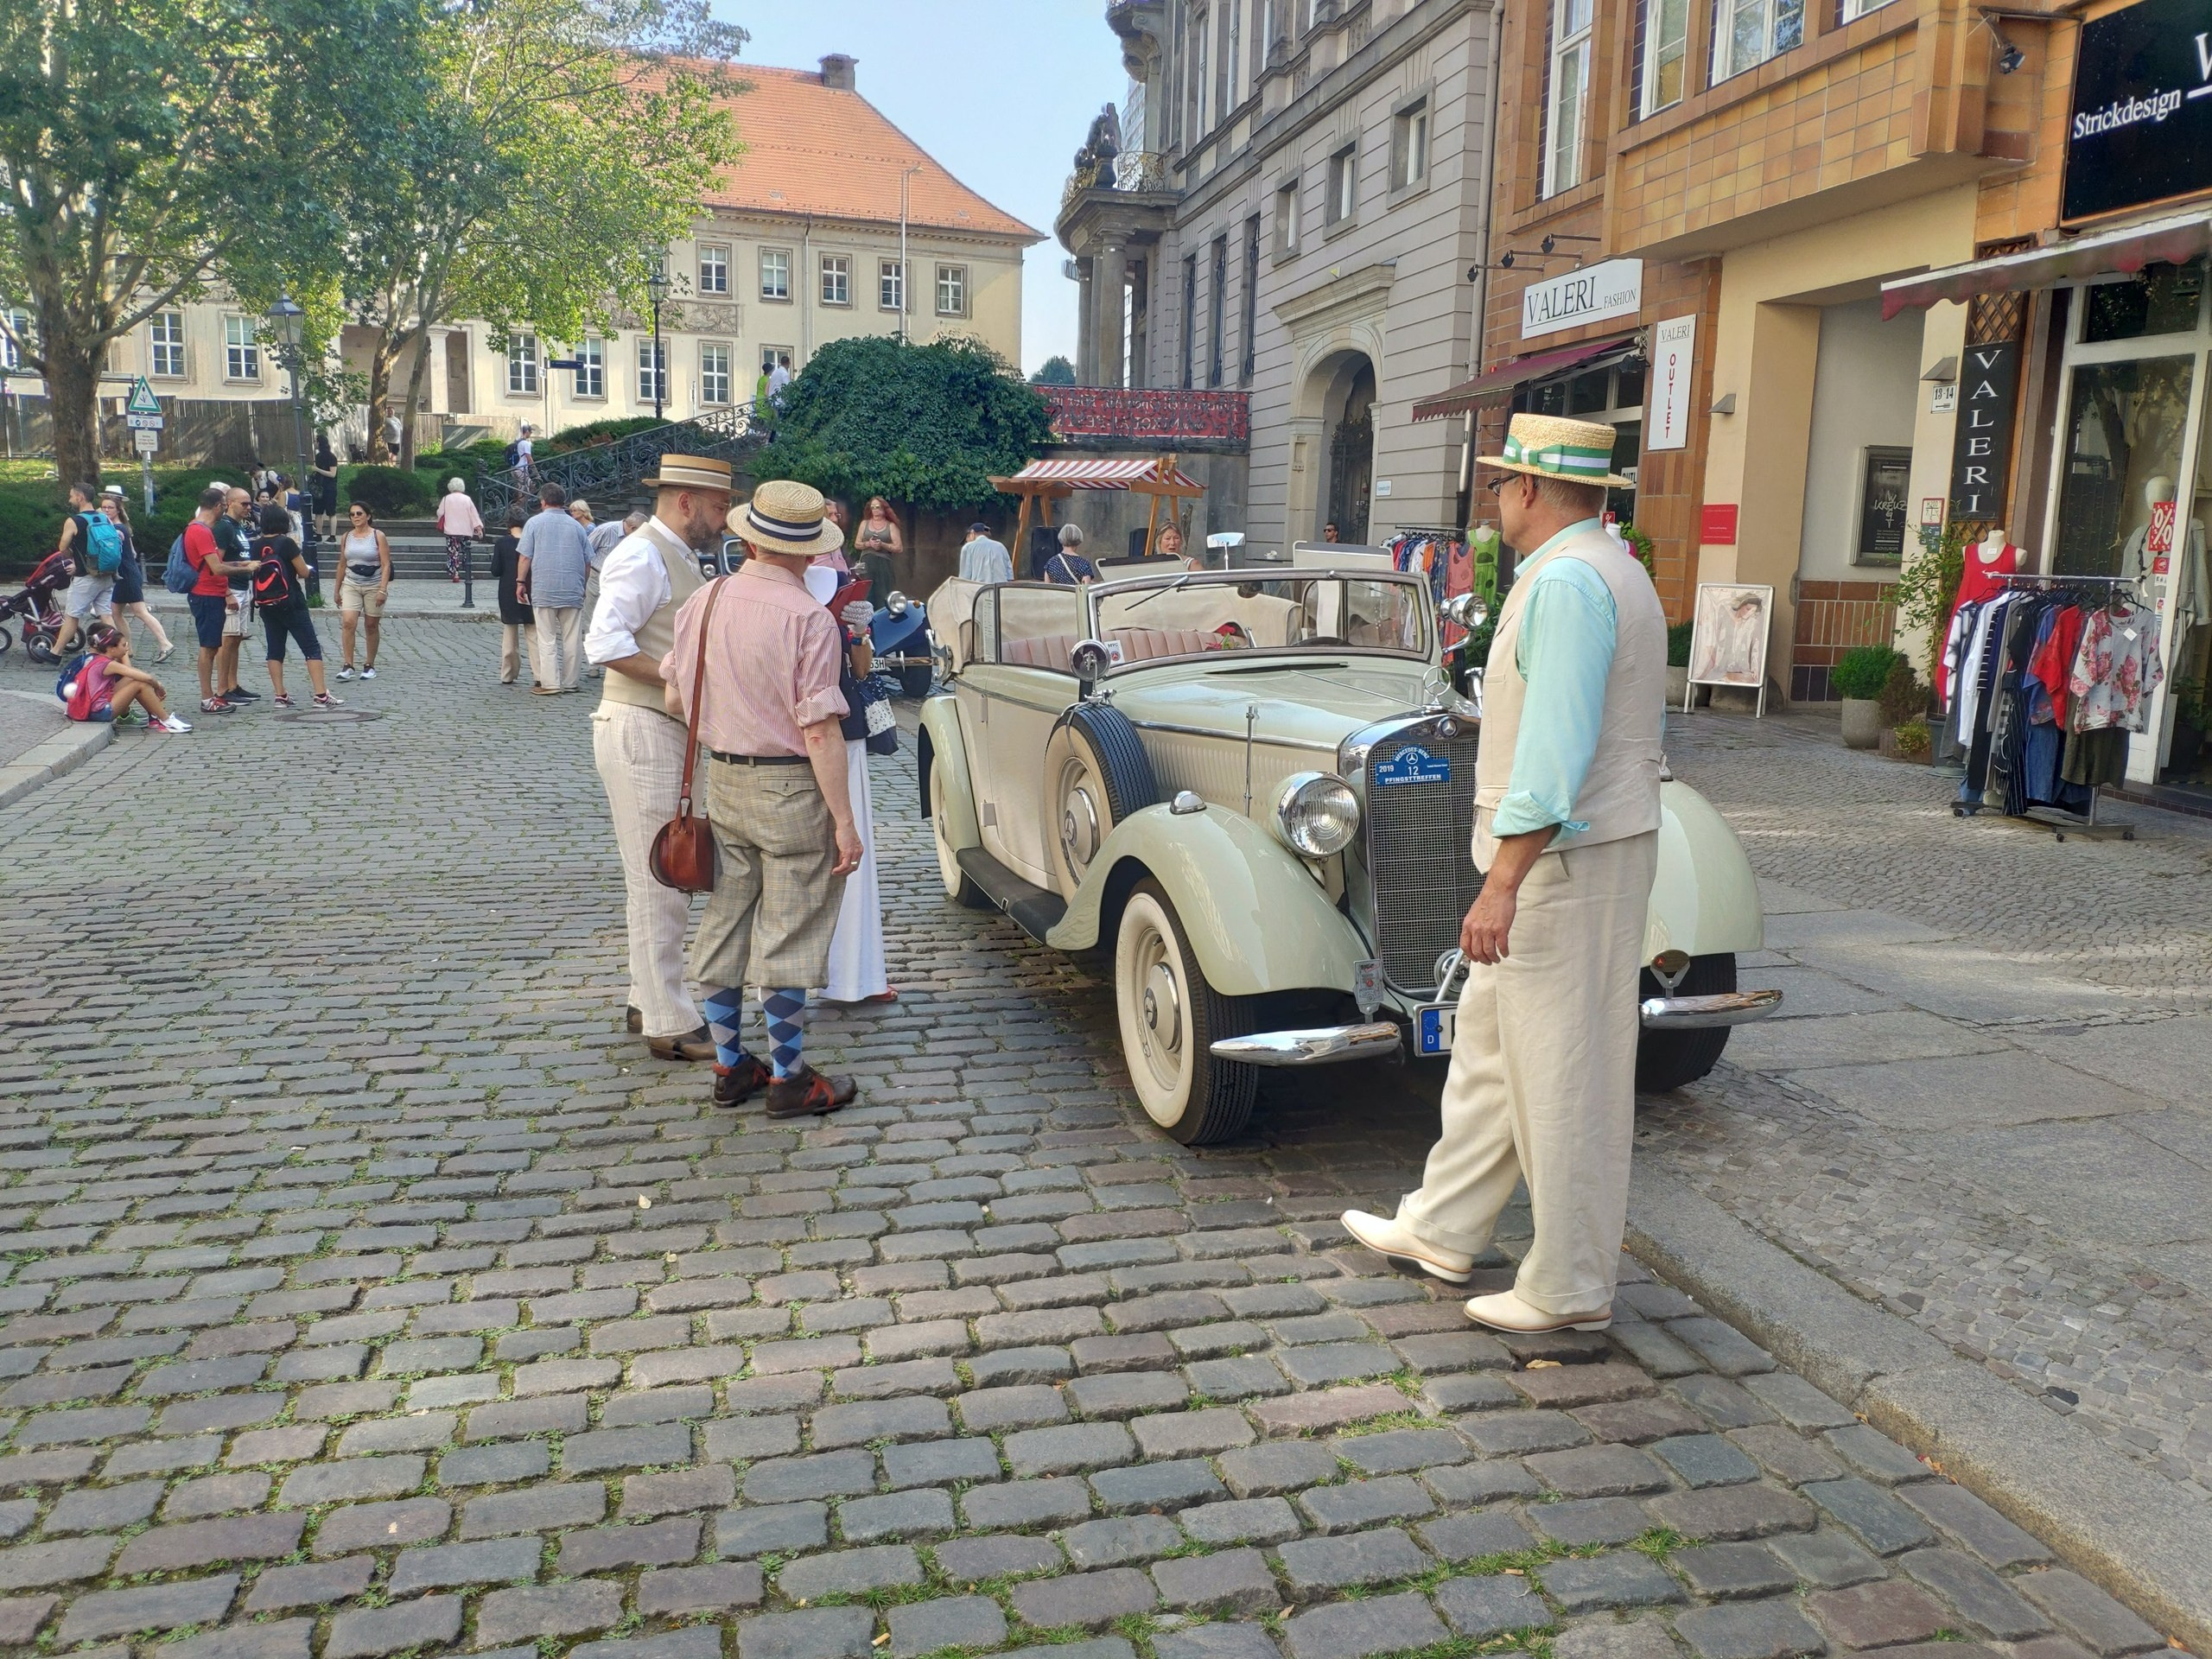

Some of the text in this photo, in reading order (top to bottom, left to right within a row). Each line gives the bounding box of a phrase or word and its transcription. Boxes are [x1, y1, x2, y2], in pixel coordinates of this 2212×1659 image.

[2074, 88, 2182, 139] Strickdesign
[1528, 276, 1637, 324] VALERI FASHION
[1661, 324, 1690, 341] VALERI
[1665, 353, 1676, 439] OUTLET
[1963, 349, 2003, 512] VALERI
[1394, 747, 1430, 762] MERCEDES-BENZ
[1384, 774, 1441, 783] PFINGSTTREFFEN
[1408, 766, 1419, 776] 12
[1427, 1034, 1434, 1044] D
